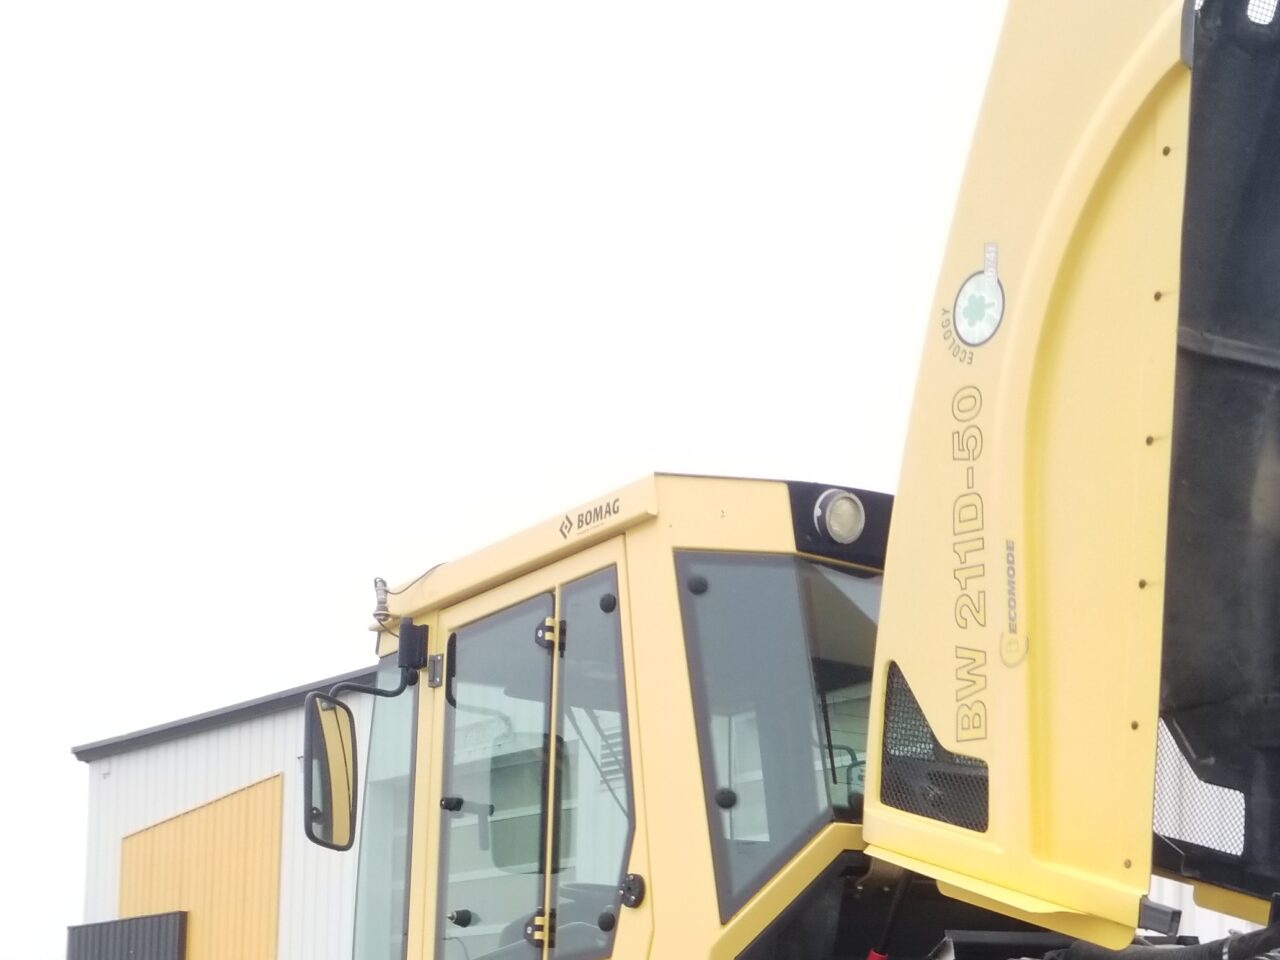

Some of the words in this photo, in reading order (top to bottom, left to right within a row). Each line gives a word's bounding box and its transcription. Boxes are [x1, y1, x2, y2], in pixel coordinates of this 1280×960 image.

[941, 308, 974, 365] ECOLOGY
[578, 499, 619, 528] BOMAG
[951, 385, 986, 629] 211D-50
[1005, 539, 1017, 634] ECOMODE
[955, 645, 987, 742] BW
